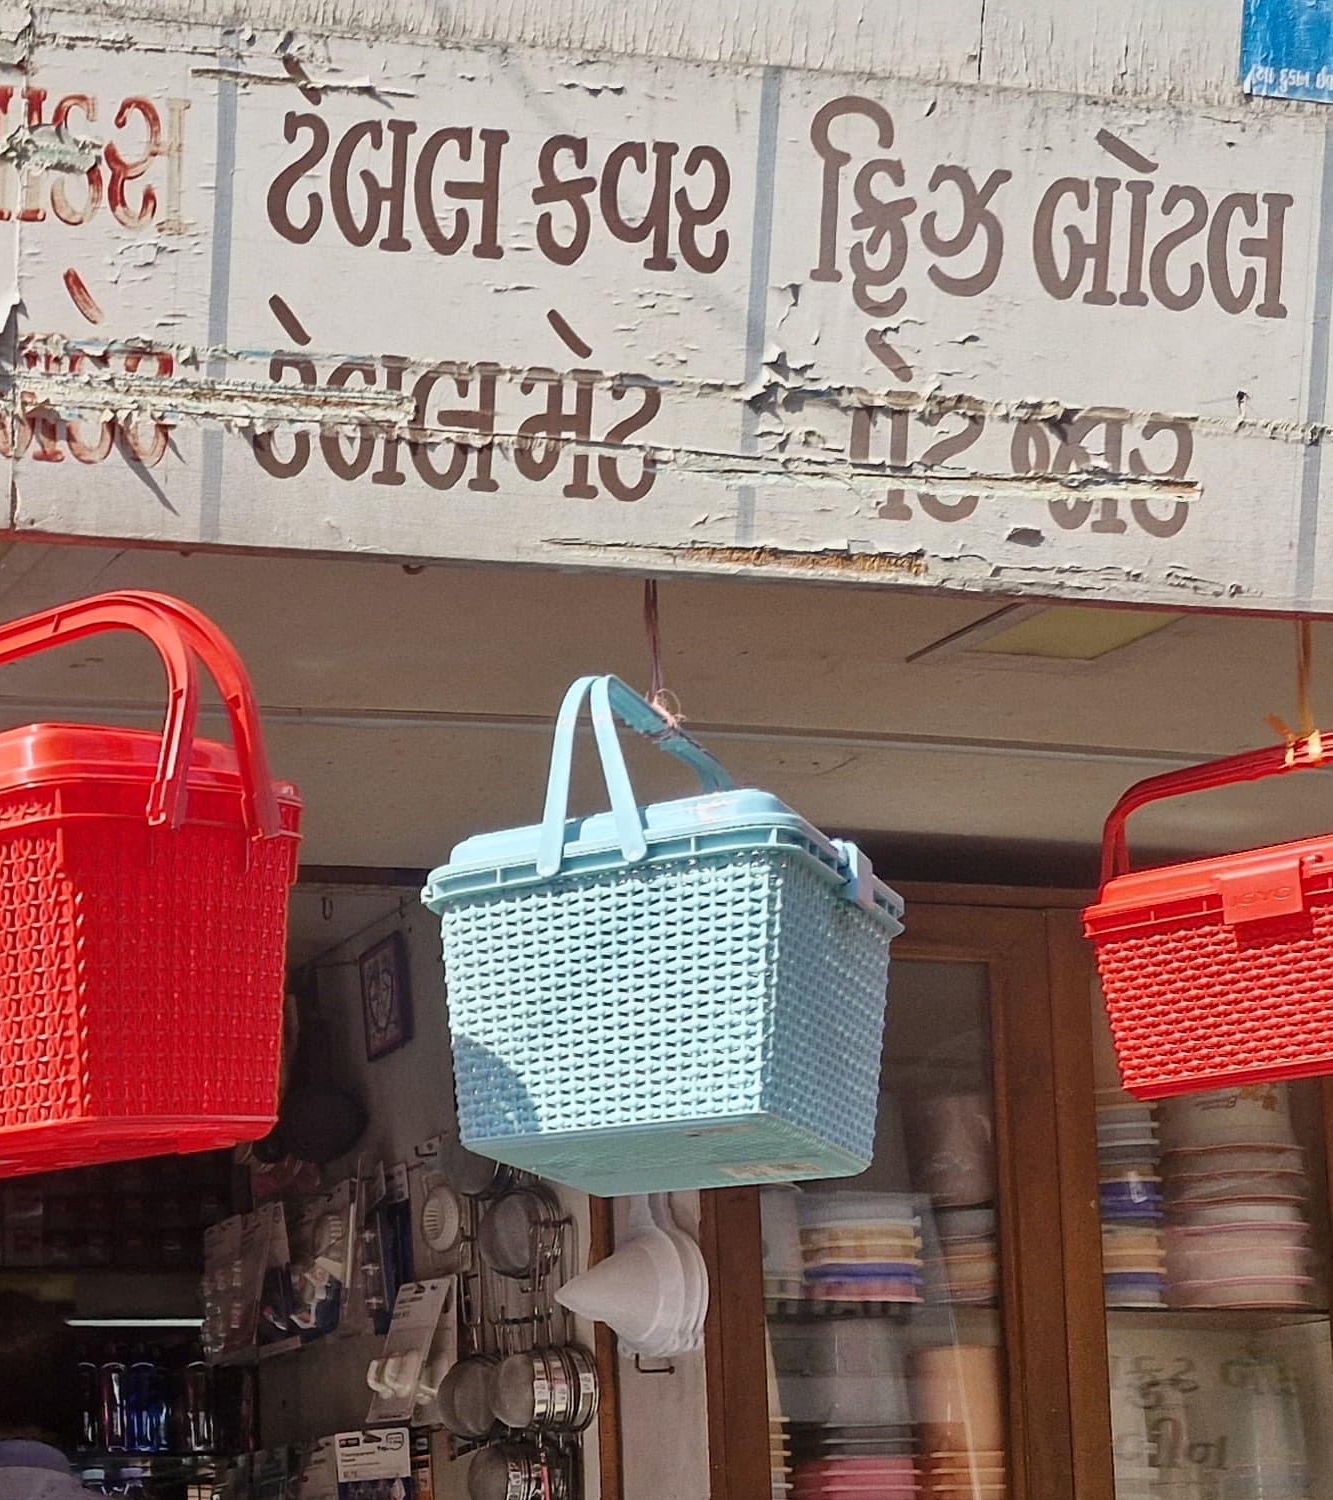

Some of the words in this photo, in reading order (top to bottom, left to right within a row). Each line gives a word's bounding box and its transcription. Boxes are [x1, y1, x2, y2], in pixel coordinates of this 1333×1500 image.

[266, 54, 510, 259] ટેબલ
[532, 134, 731, 274] કવર
[1033, 127, 1294, 320] બોટલ
